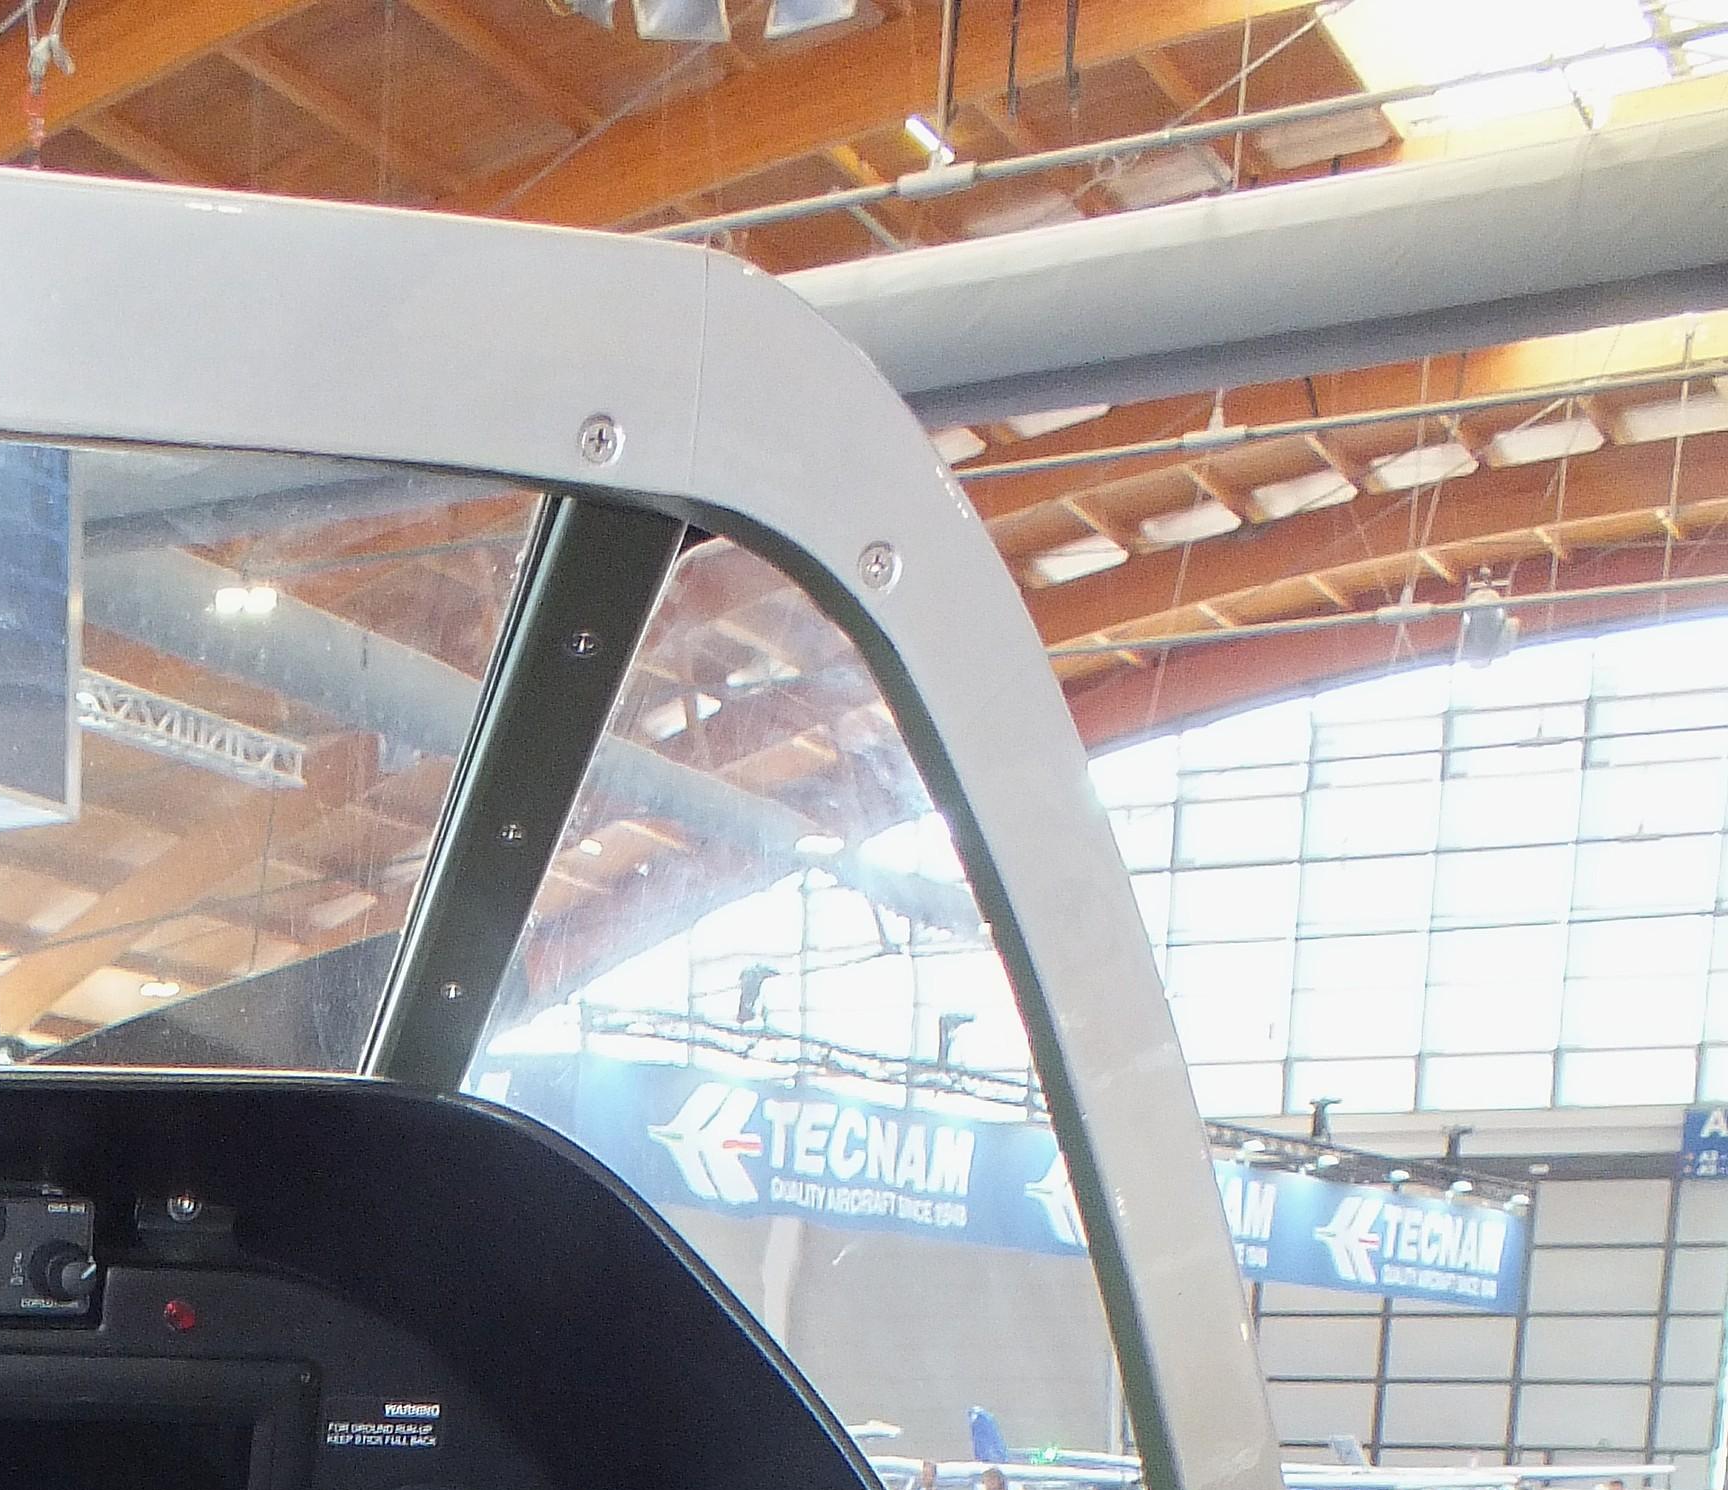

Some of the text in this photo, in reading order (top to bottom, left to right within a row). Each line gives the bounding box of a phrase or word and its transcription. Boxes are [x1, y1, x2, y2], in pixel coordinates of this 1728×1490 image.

[762, 1099, 975, 1196] TECNAM
[826, 1186, 896, 1216] AIRCRAFT
[1382, 1204, 1507, 1274] TECNAM
[384, 1434, 409, 1446] FULL
